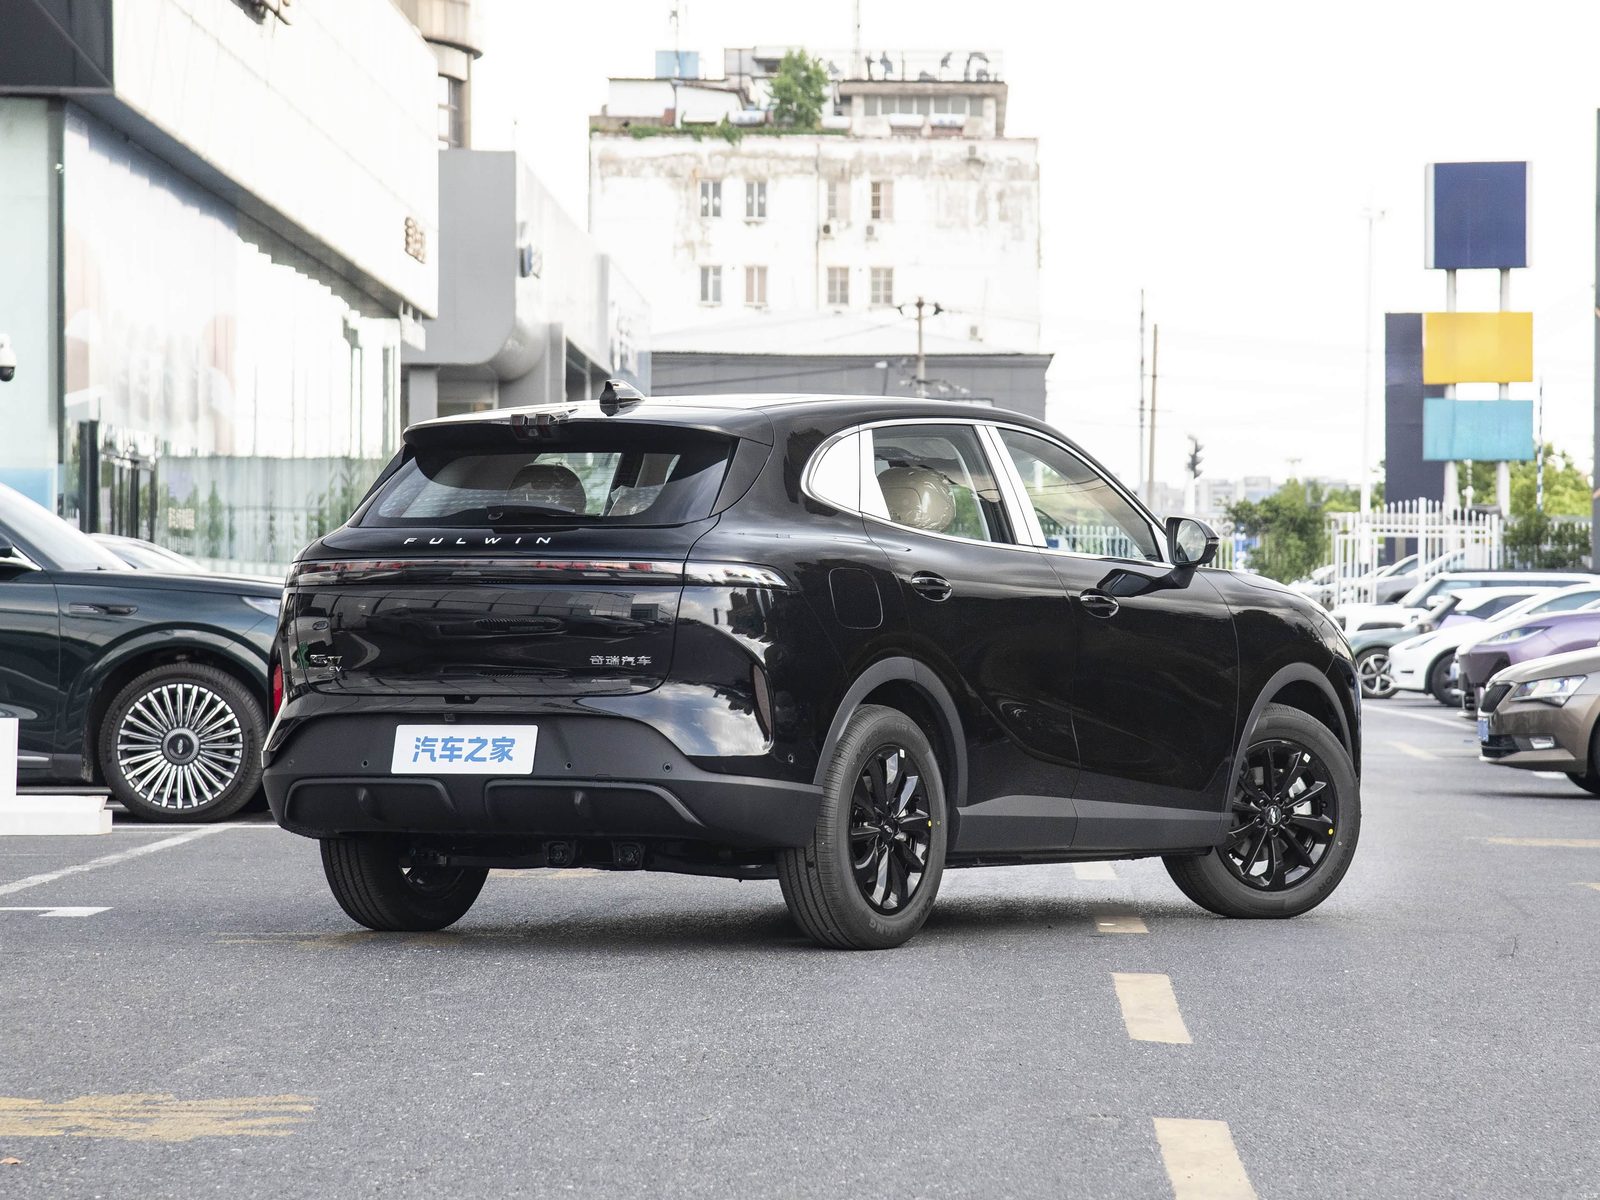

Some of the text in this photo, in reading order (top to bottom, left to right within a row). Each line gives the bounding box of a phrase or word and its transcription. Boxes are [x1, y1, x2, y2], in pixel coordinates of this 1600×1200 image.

[403, 537, 552, 545] FULWIN
[589, 655, 652, 666] 奇瑞汽车
[412, 736, 516, 763] 汽车之家
